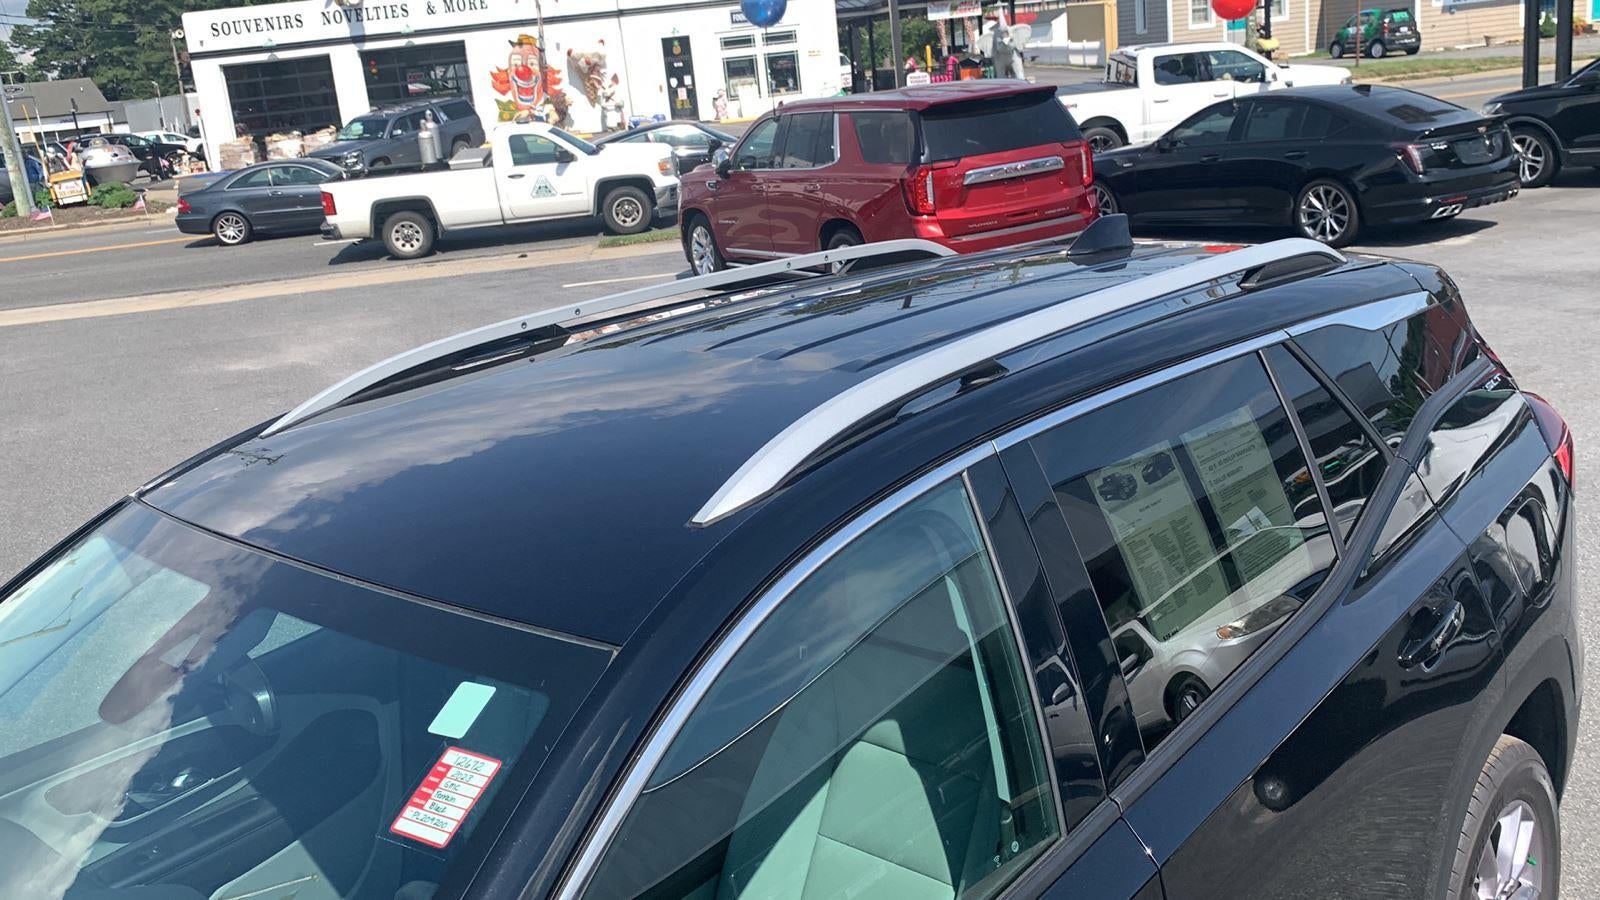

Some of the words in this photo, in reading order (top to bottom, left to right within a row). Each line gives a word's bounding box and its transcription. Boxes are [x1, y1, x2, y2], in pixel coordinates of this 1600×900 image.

[210, 14, 304, 37] SOUVENIRS
[321, 3, 409, 25] NOVELTIES
[426, 1, 437, 15] &
[444, 0, 488, 13] MORE
